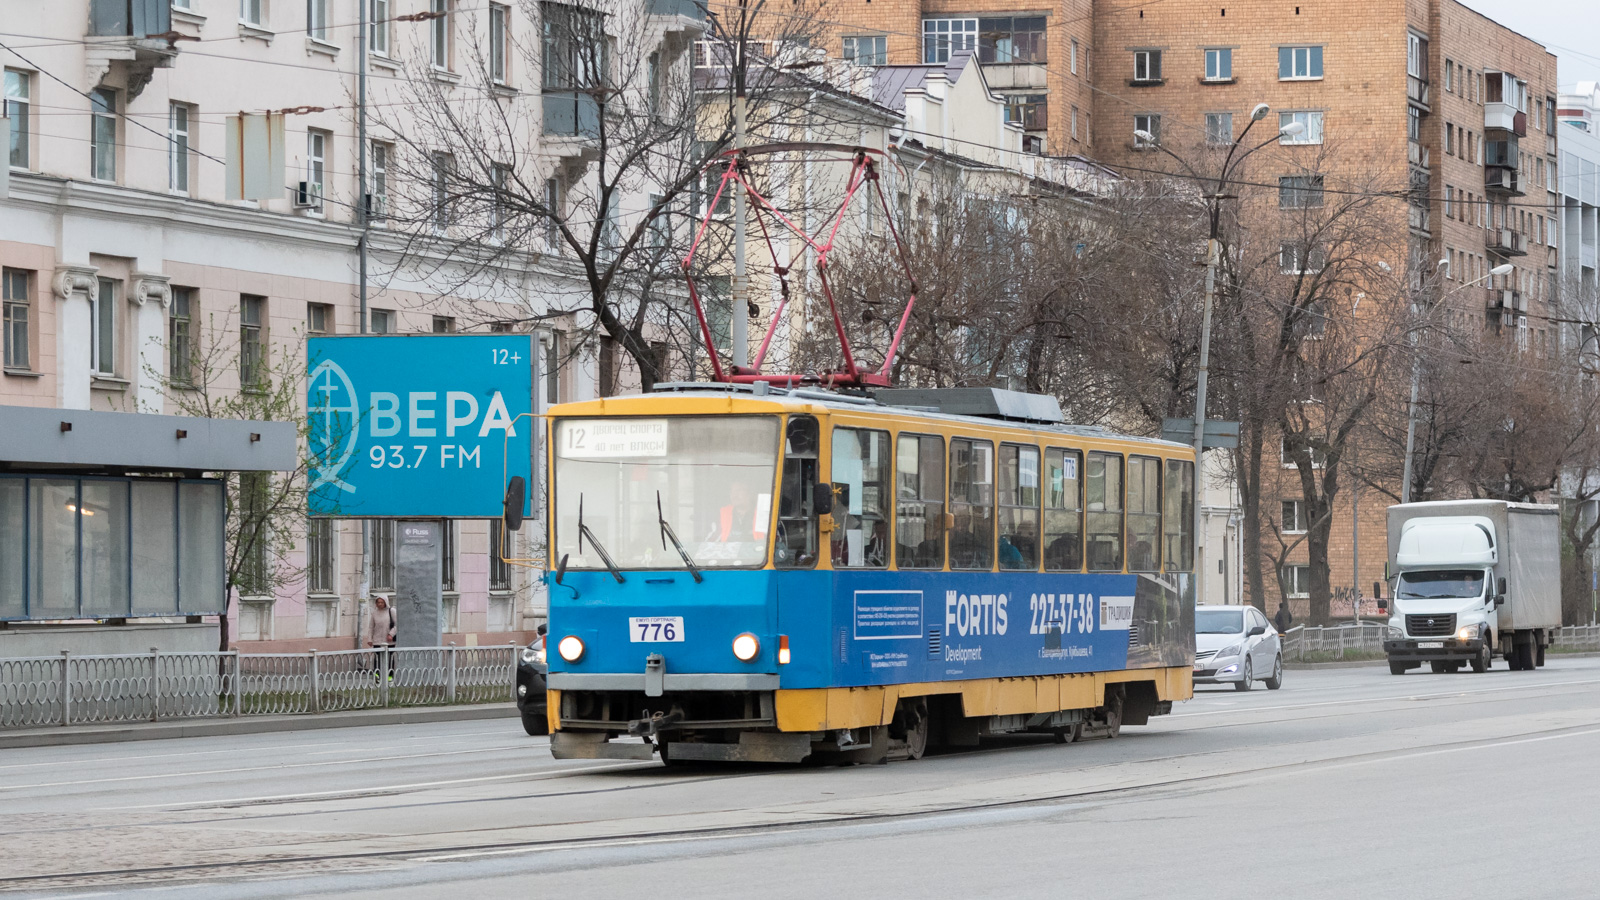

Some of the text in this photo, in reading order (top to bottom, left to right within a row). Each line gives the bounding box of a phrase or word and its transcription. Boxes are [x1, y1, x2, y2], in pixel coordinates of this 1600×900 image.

[492, 348, 522, 365] 12+
[370, 391, 517, 438] ВЕРА
[568, 428, 586, 449] 12
[369, 445, 481, 469] 93.7 FM
[1065, 459, 1075, 478] 776
[945, 590, 1008, 637] FORTIS
[1030, 593, 1094, 635] 227-37-38
[638, 623, 676, 641] 776
[945, 644, 982, 666] Development
